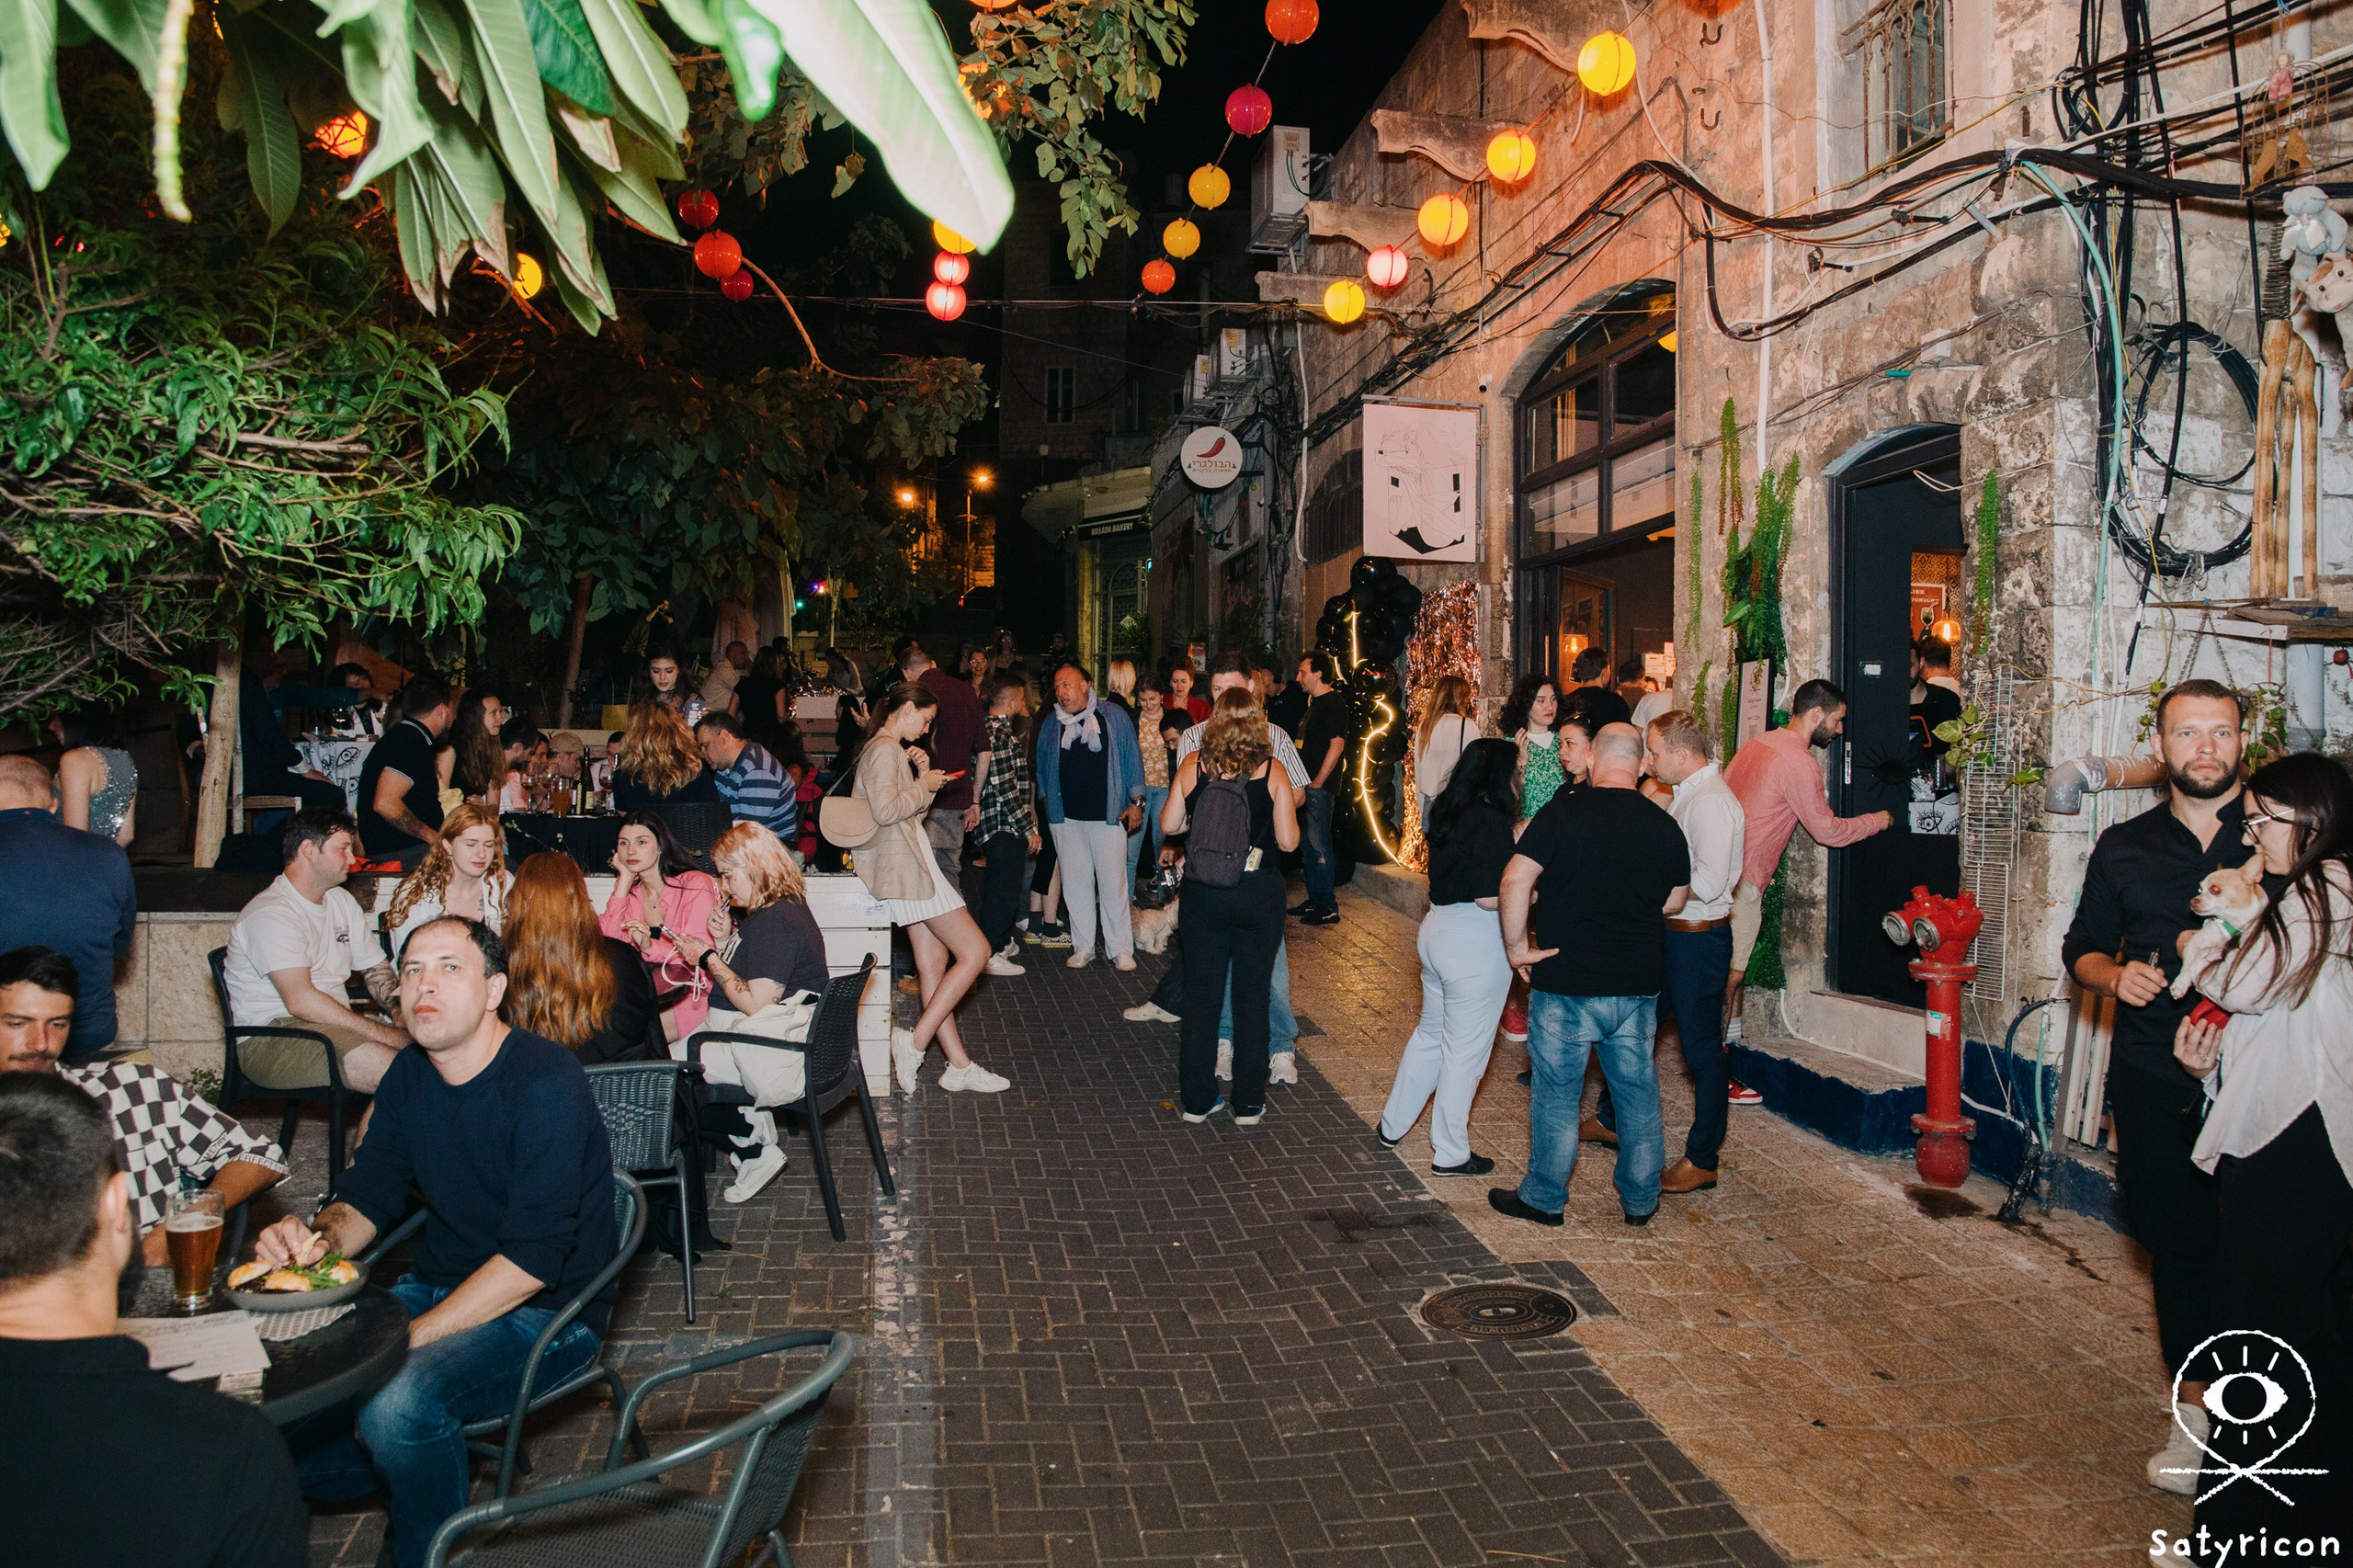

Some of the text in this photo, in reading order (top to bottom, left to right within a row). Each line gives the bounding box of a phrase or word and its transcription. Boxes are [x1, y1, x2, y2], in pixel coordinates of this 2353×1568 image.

[1192, 460, 1232, 468] הבולגרי
[1112, 522, 1134, 533] BAKERY
[232, 1153, 274, 1170] PERFECT
